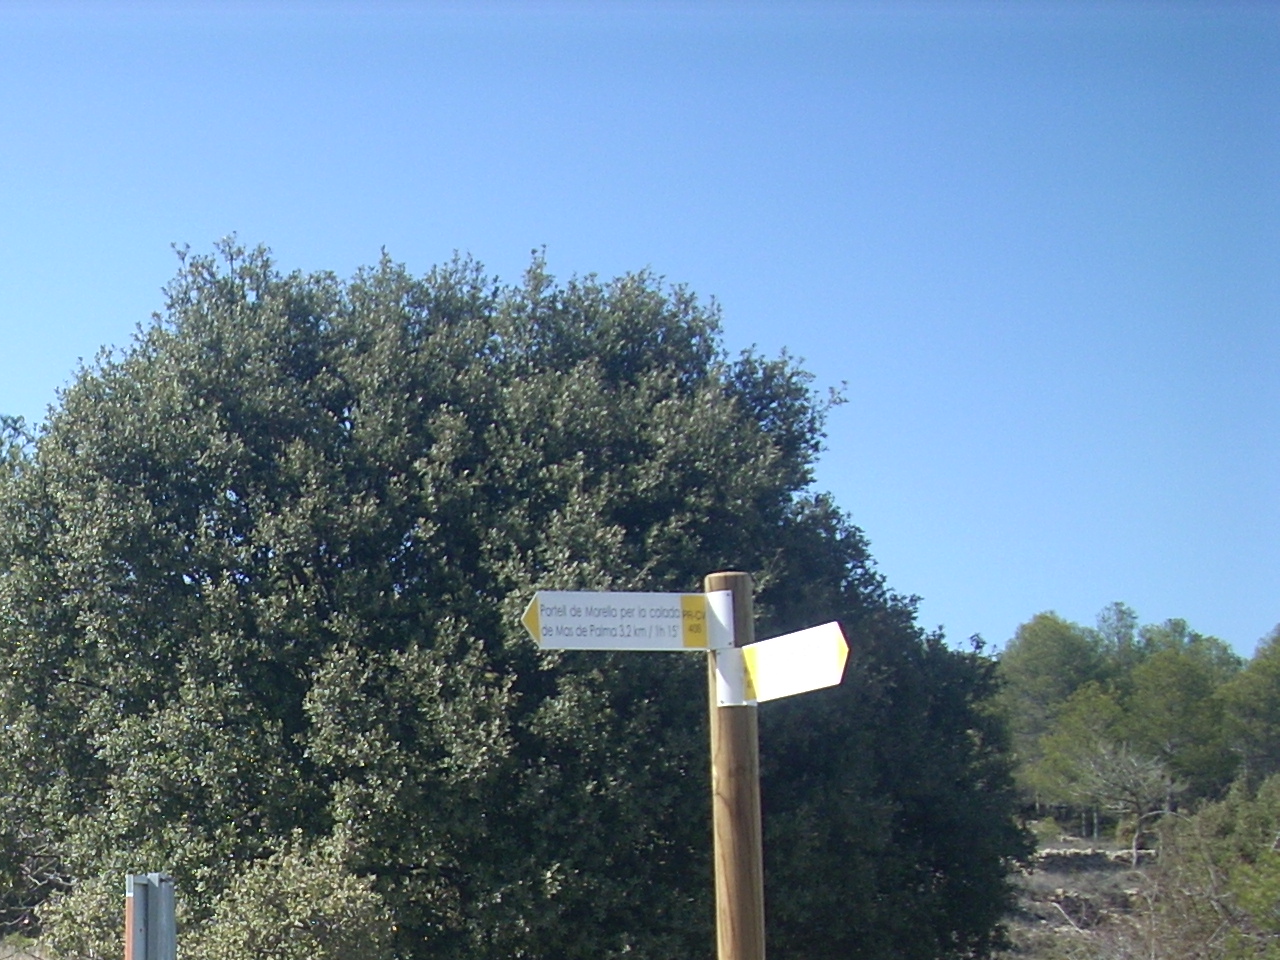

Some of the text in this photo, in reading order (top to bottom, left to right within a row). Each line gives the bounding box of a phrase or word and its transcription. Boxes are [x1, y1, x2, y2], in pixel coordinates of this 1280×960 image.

[540, 604, 566, 617] Portell
[569, 604, 582, 618] de
[584, 604, 618, 618] Morella
[620, 607, 635, 620] per
[638, 605, 647, 618] la
[542, 624, 553, 637] de
[555, 624, 573, 637] Mas
[575, 624, 588, 637] de
[589, 624, 617, 637] Palma
[634, 624, 647, 637] km
